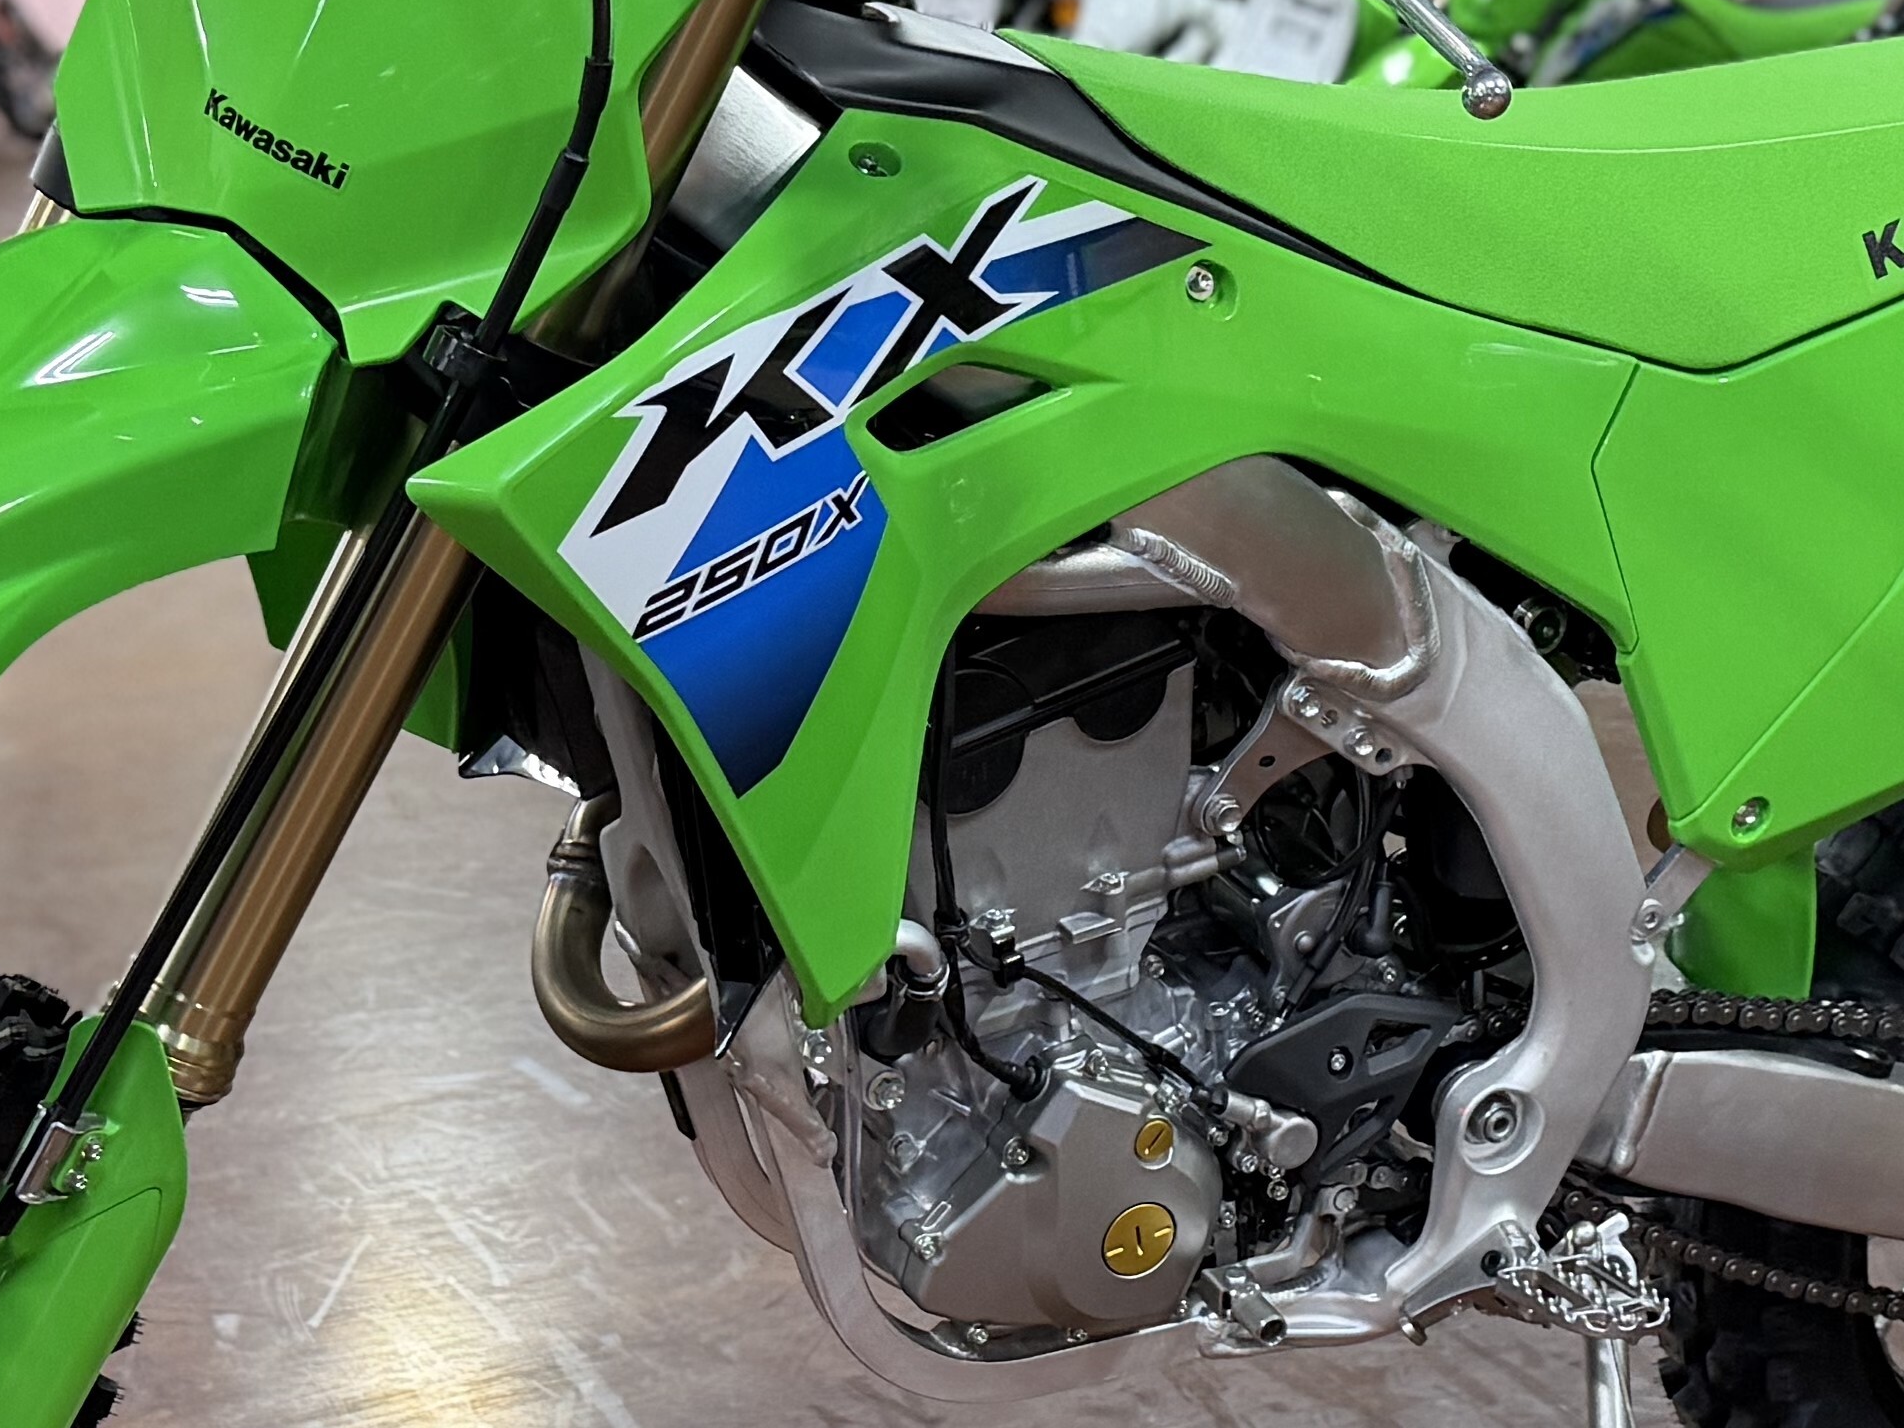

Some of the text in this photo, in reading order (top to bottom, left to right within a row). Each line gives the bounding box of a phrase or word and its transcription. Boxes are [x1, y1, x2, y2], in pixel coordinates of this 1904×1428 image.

[203, 88, 350, 190] Kawasaki
[586, 175, 1044, 540] KX
[631, 472, 870, 642] 250X
